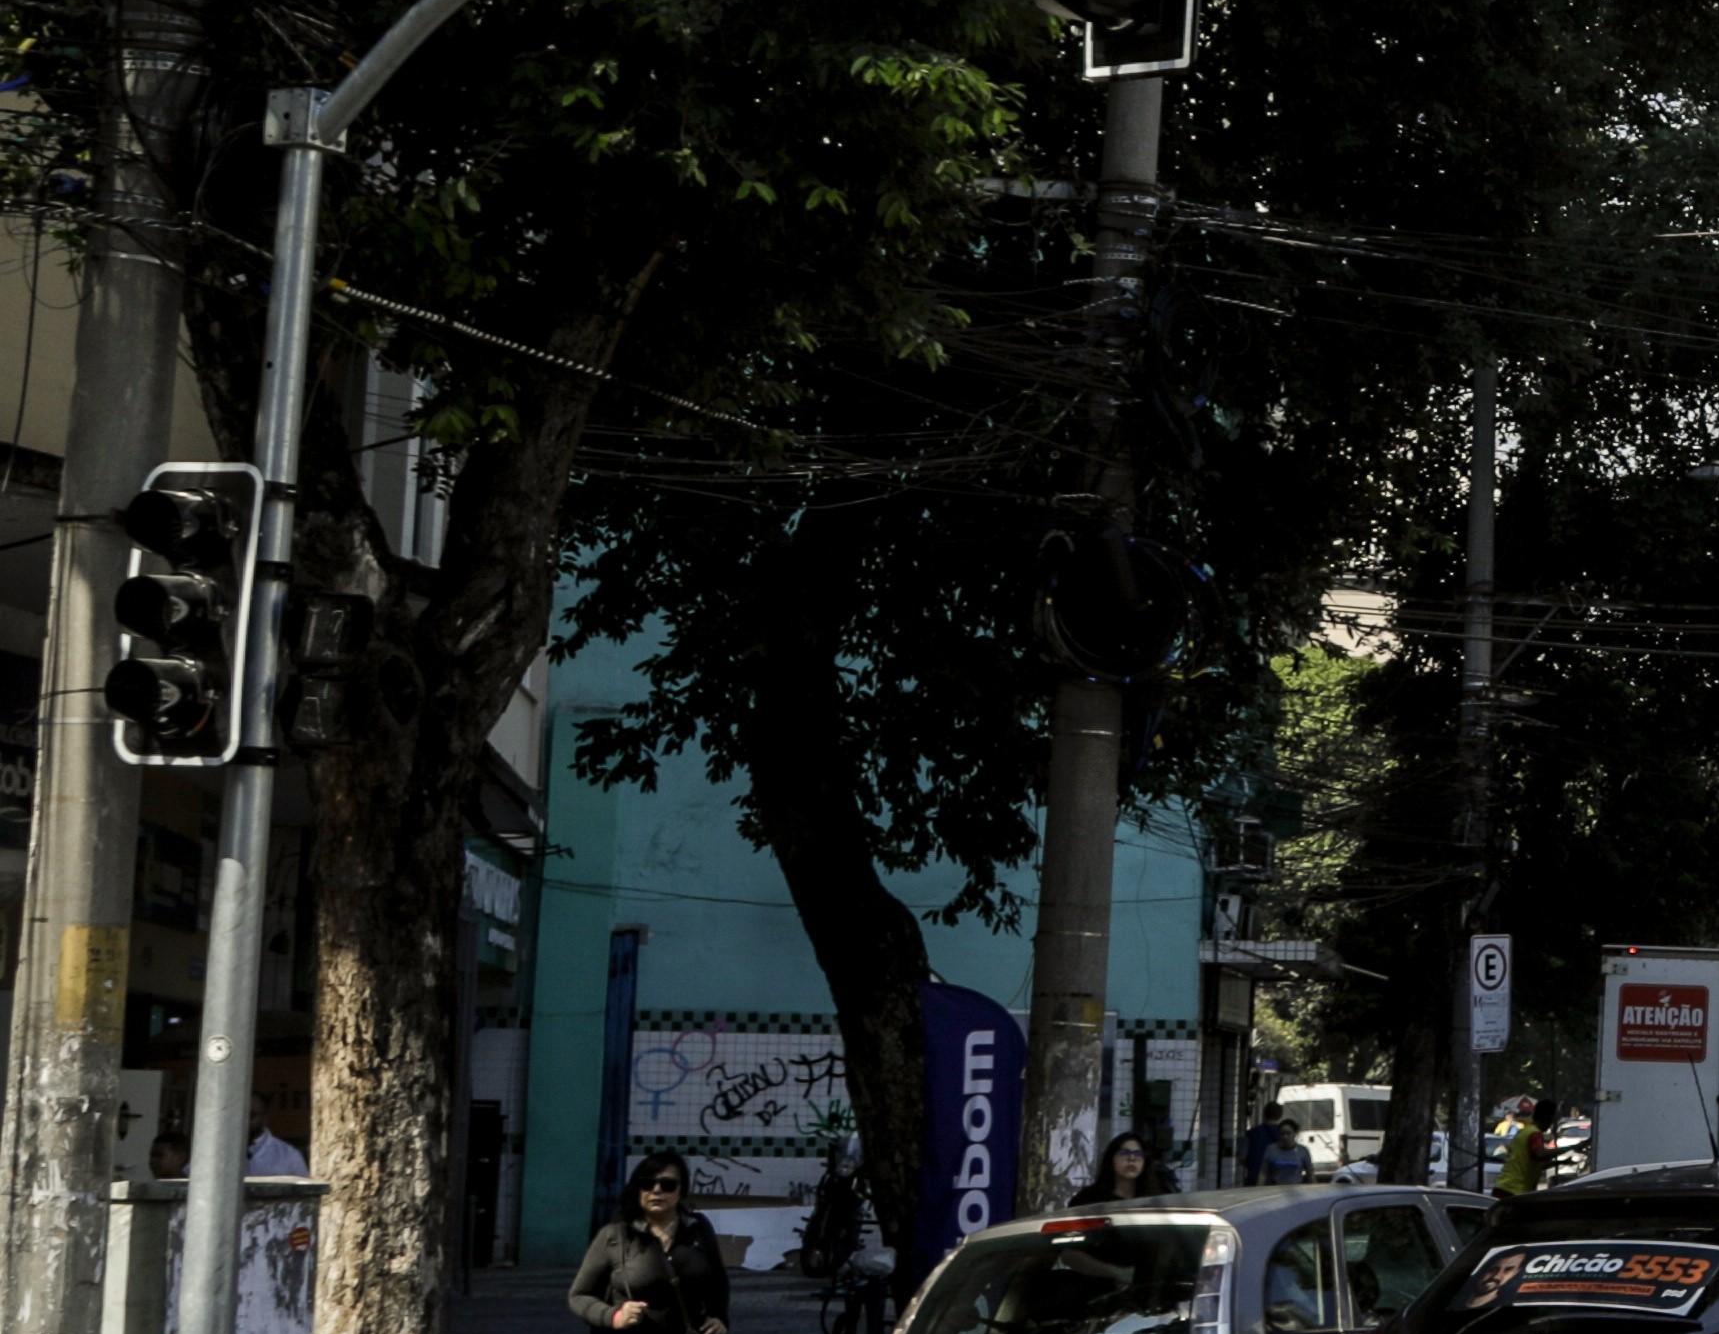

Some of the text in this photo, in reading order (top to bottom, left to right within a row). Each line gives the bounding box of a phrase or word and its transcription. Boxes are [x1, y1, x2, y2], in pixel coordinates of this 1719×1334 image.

[1485, 954, 1497, 981] E
[1623, 1004, 1704, 1029] ATENÇÃO
[1524, 1253, 1711, 1285] Chicão 5553
